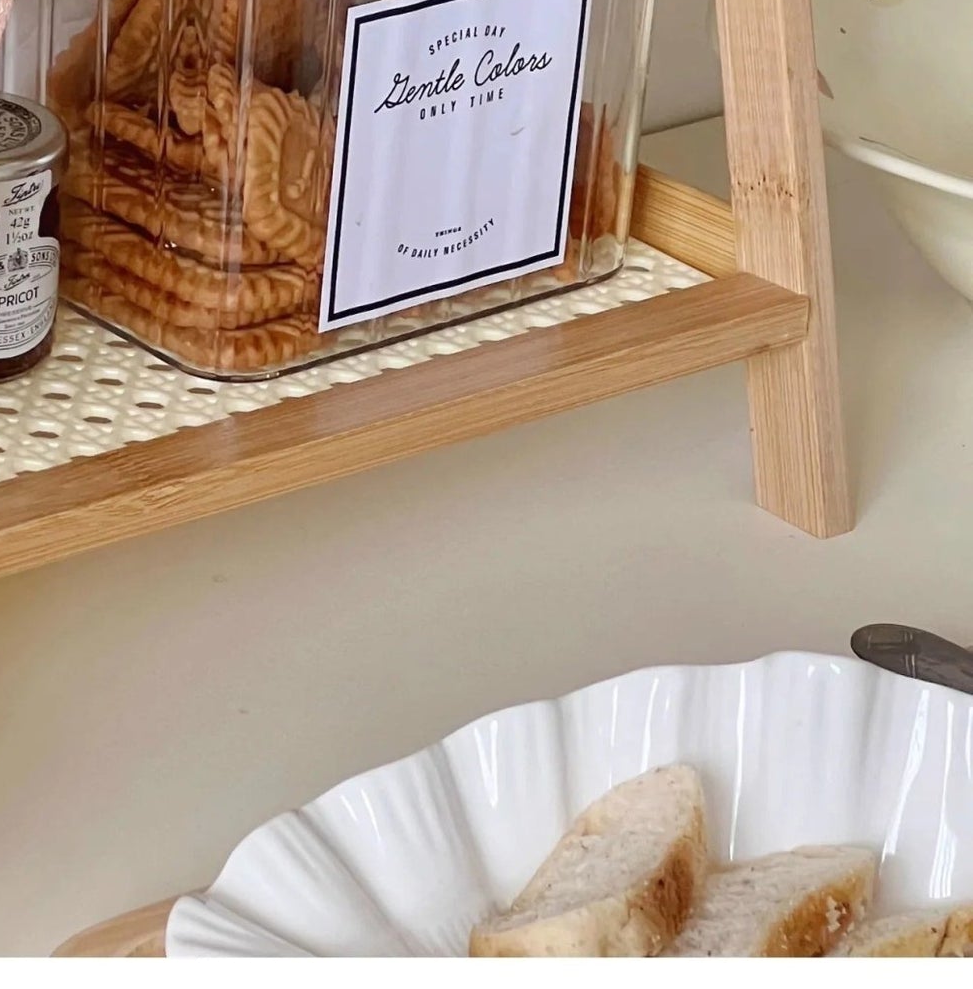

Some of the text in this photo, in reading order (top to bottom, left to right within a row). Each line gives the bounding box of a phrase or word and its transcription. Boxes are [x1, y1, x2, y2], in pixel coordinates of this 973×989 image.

[428, 25, 506, 55] SPECIAL DAY
[374, 42, 553, 114] Gentle Colors
[420, 87, 505, 120] ONLY TIME
[10, 216, 31, 229] 42g
[397, 218, 494, 258] OF DAILY NECESSITY
[30, 251, 50, 263] SONS
